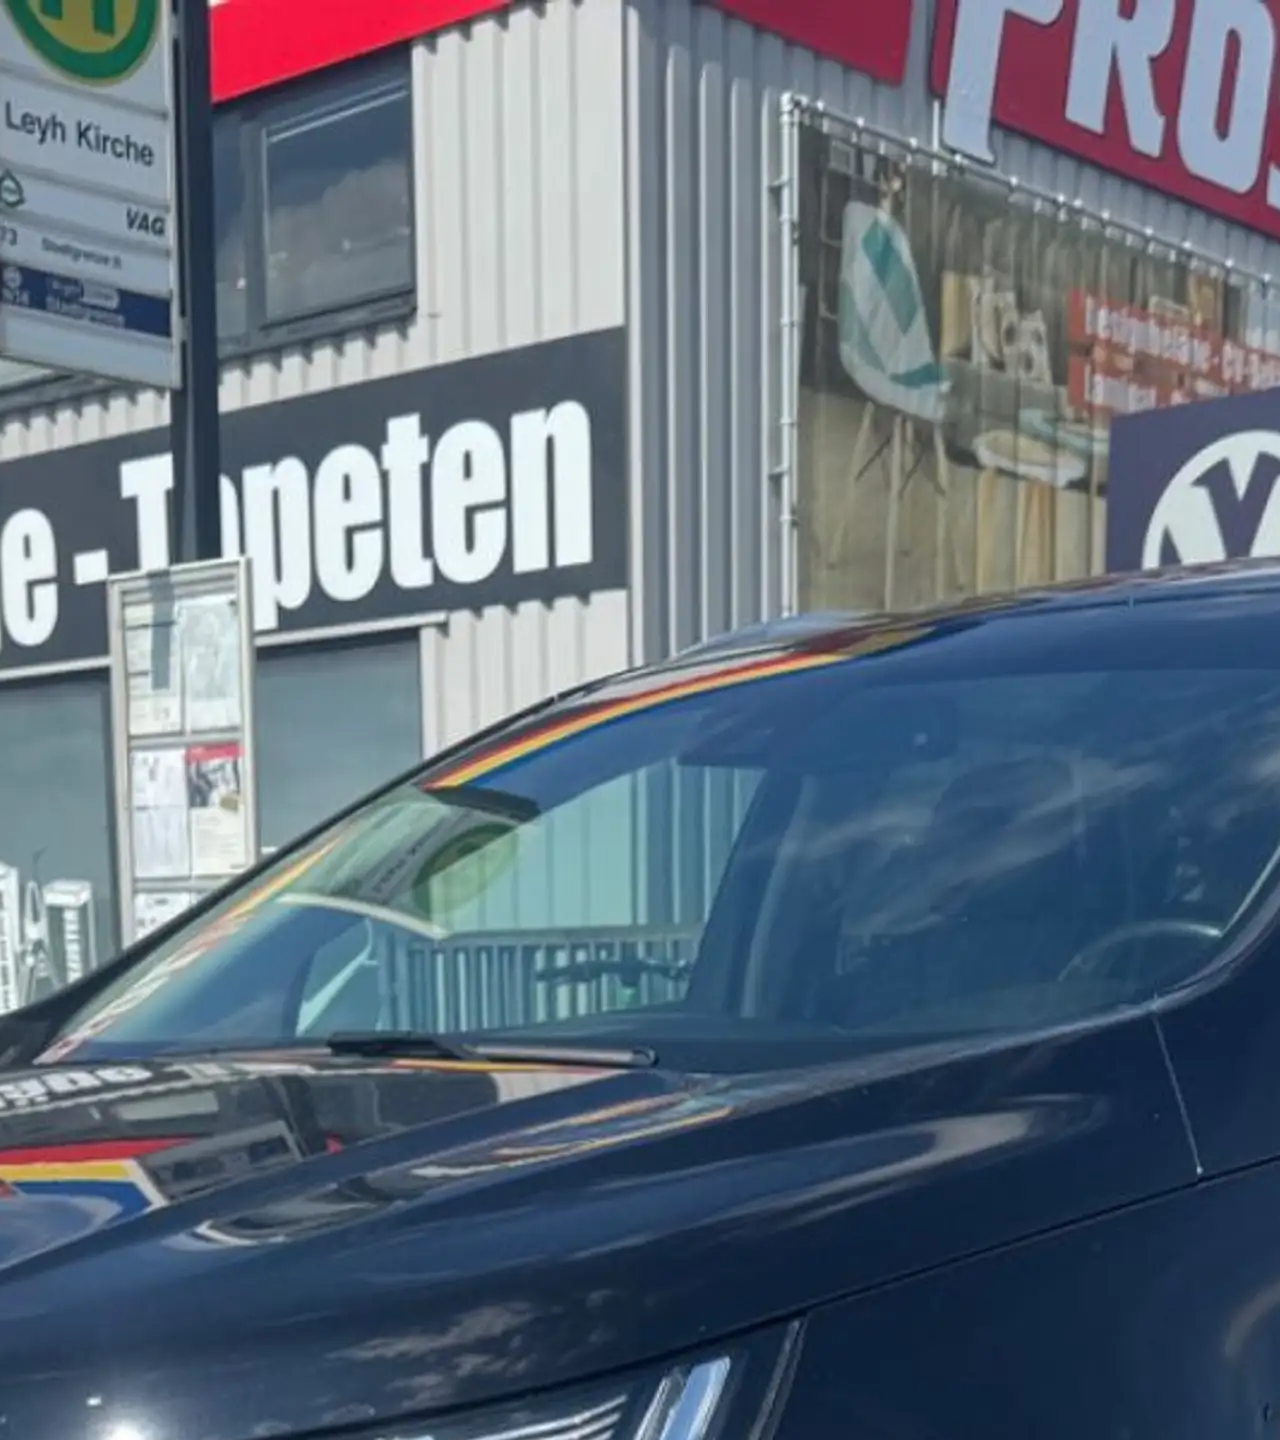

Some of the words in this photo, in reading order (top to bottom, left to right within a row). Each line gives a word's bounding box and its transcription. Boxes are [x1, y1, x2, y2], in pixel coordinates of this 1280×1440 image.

[4, 101, 67, 146] Leyh
[75, 121, 155, 167] Kirche
[125, 207, 166, 236] VAG
[120, 400, 594, 631] Tpeten
